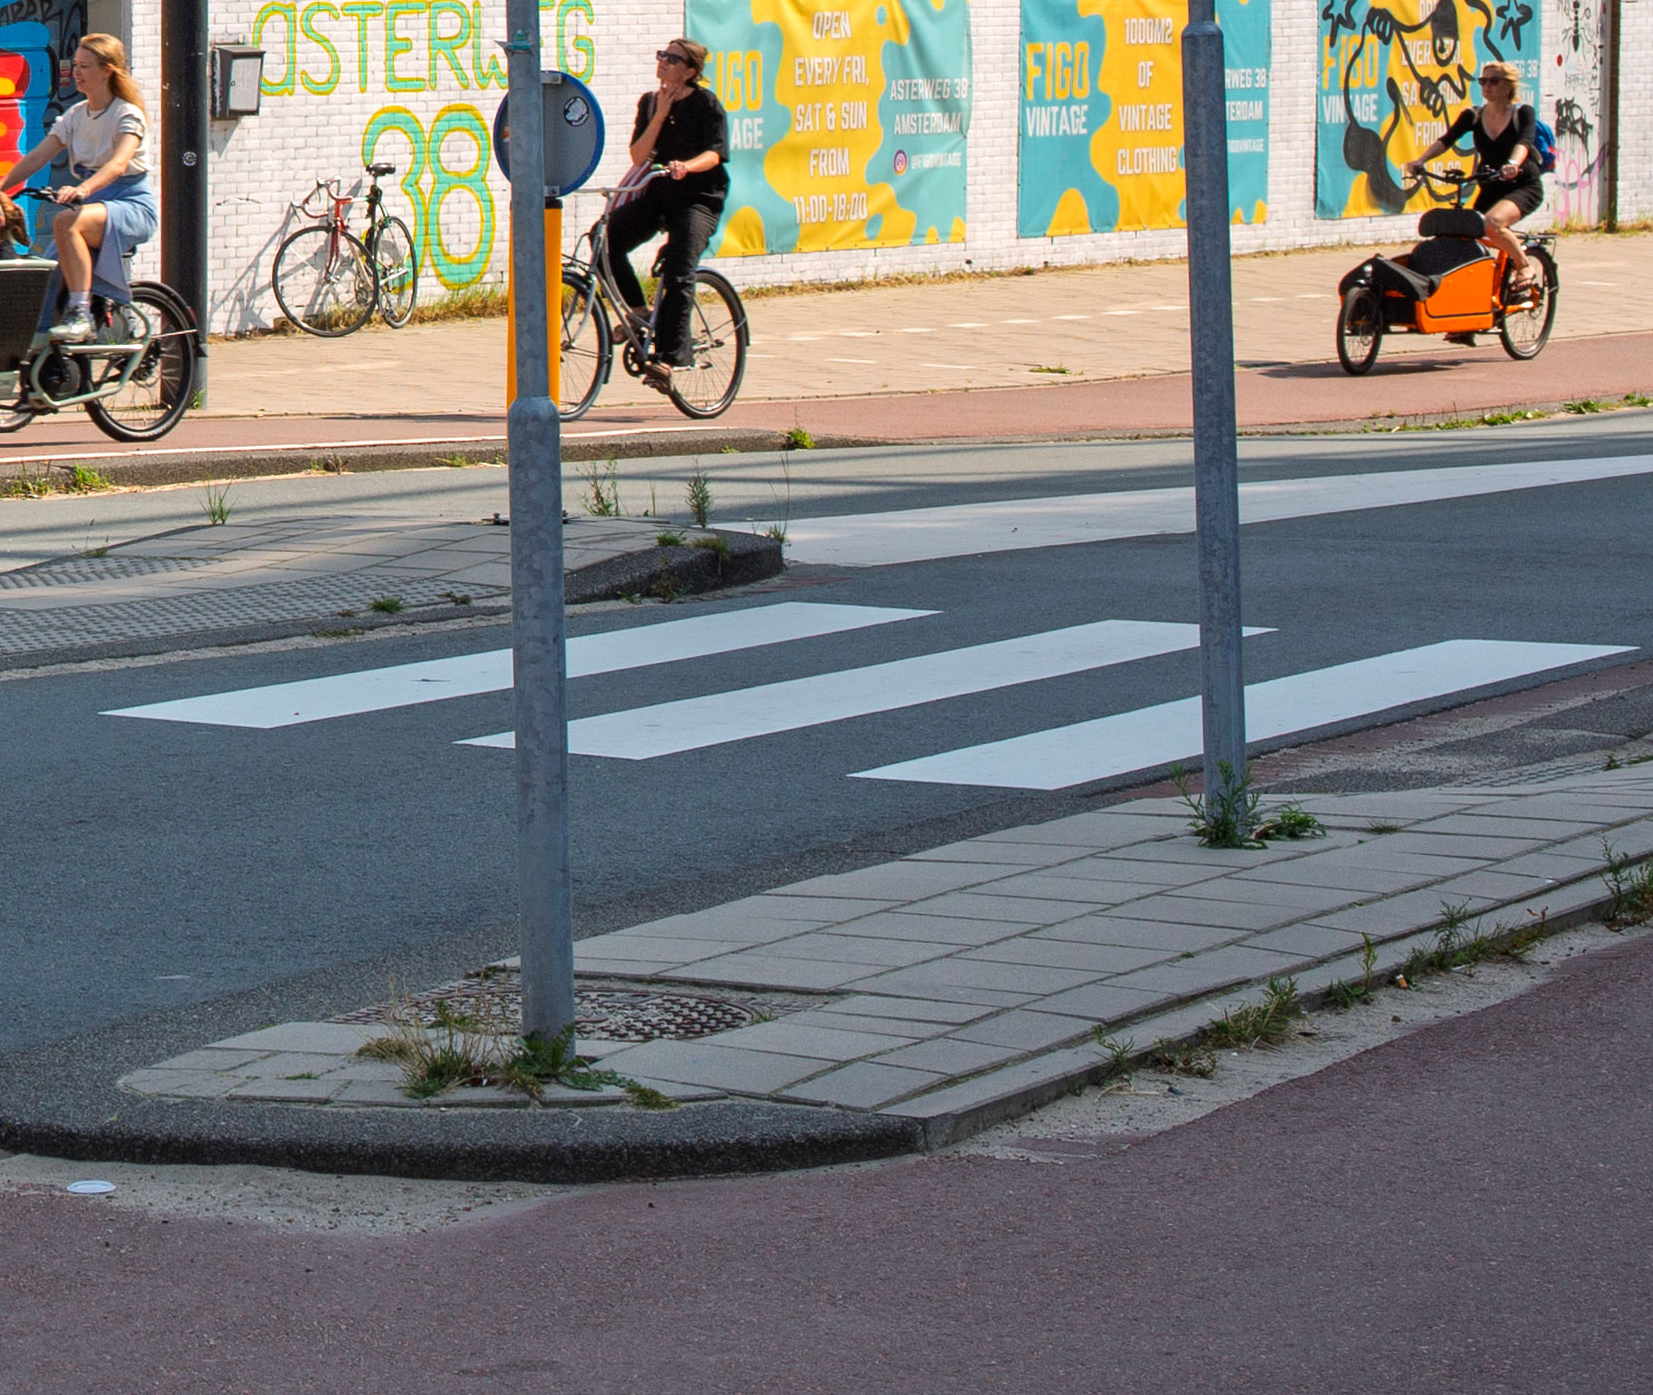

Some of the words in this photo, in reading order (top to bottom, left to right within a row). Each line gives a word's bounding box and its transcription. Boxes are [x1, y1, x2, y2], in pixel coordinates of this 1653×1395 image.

[812, 10, 852, 40] OPEN
[1124, 17, 1174, 45] 1000M2
[795, 56, 843, 87] EVERY
[843, 55, 869, 86] FRI,
[1026, 41, 1091, 101] FIGO
[1137, 61, 1154, 87] OF
[1254, 68, 1267, 88] 38
[889, 78, 951, 101] ASTERWEG
[953, 77, 969, 99] 38
[795, 103, 822, 132] SAT
[826, 103, 836, 129] &
[841, 101, 867, 129] SUN
[894, 111, 963, 135] AMSTERDAM
[1026, 105, 1089, 138] VINTAGE
[1118, 104, 1173, 132] VINTAGE
[1322, 94, 1379, 124] VINAGE
[808, 148, 850, 177] FROM
[1117, 147, 1177, 175] CLOTHING
[361, 103, 496, 291] 38
[793, 192, 868, 225] 11:00-18:00
